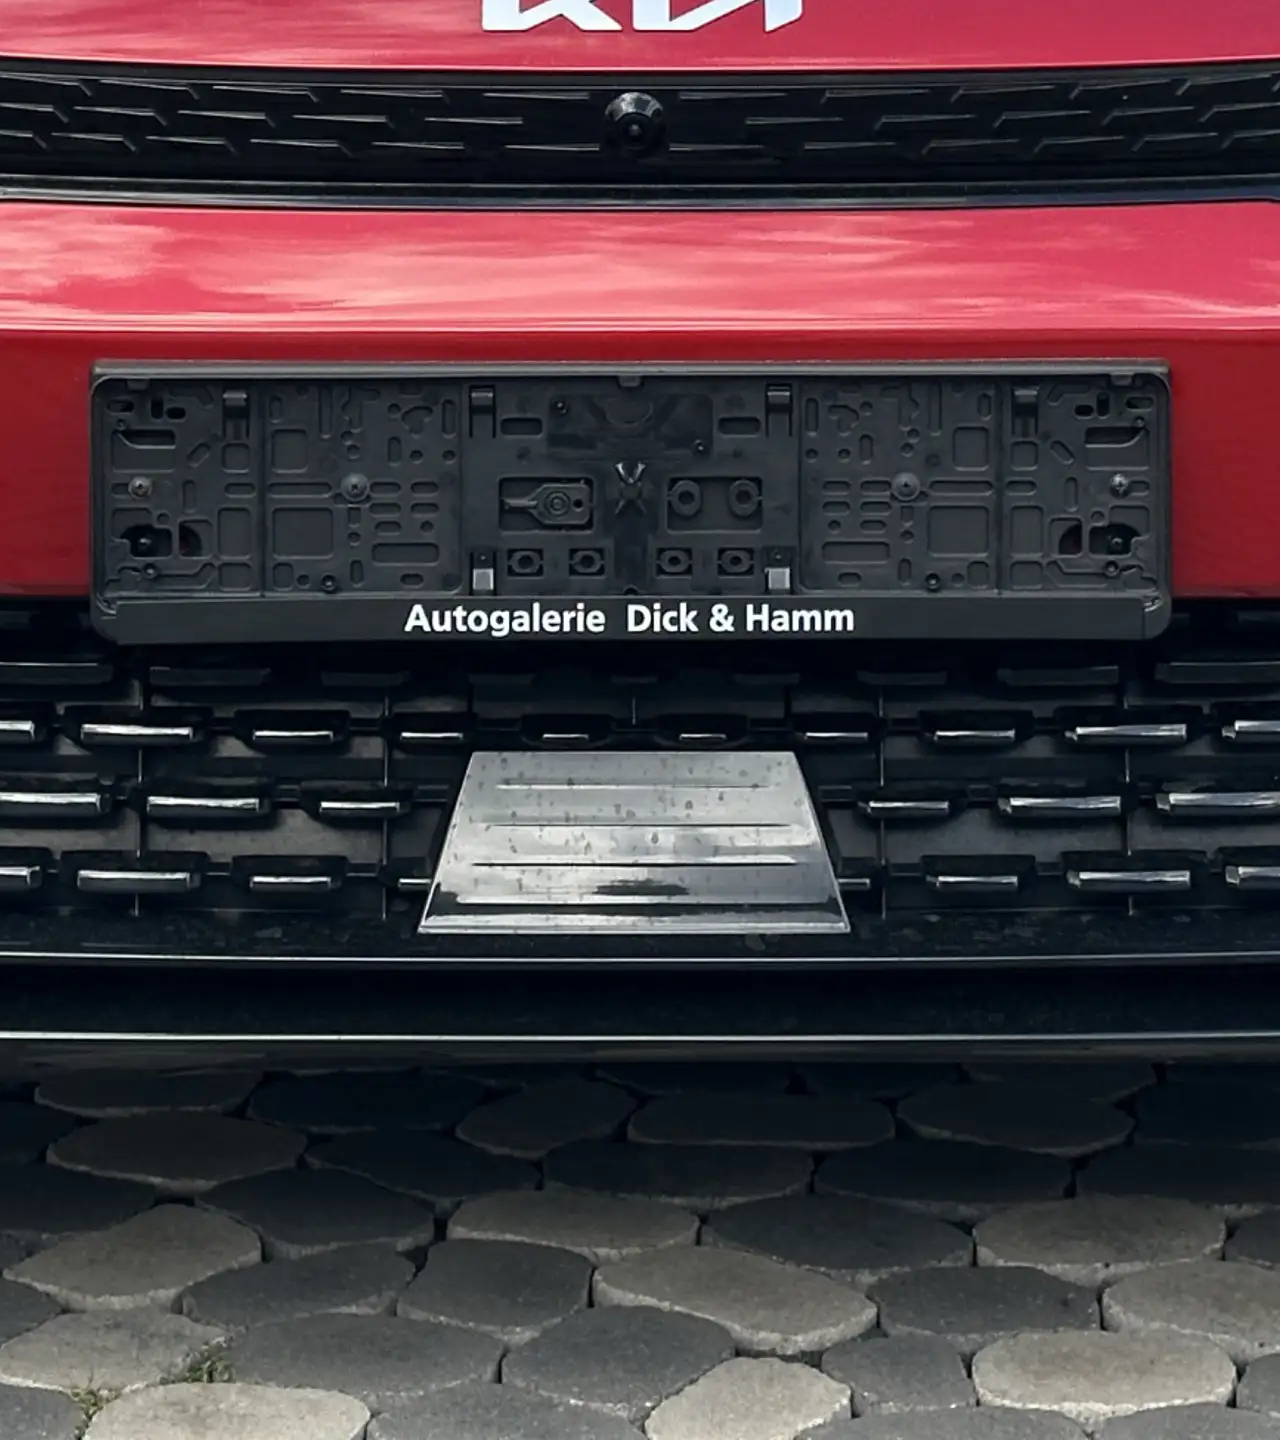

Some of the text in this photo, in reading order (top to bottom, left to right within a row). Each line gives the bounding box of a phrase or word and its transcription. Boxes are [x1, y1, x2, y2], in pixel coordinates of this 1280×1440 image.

[405, 602, 853, 637] Autogalerie Dick & Hamm
